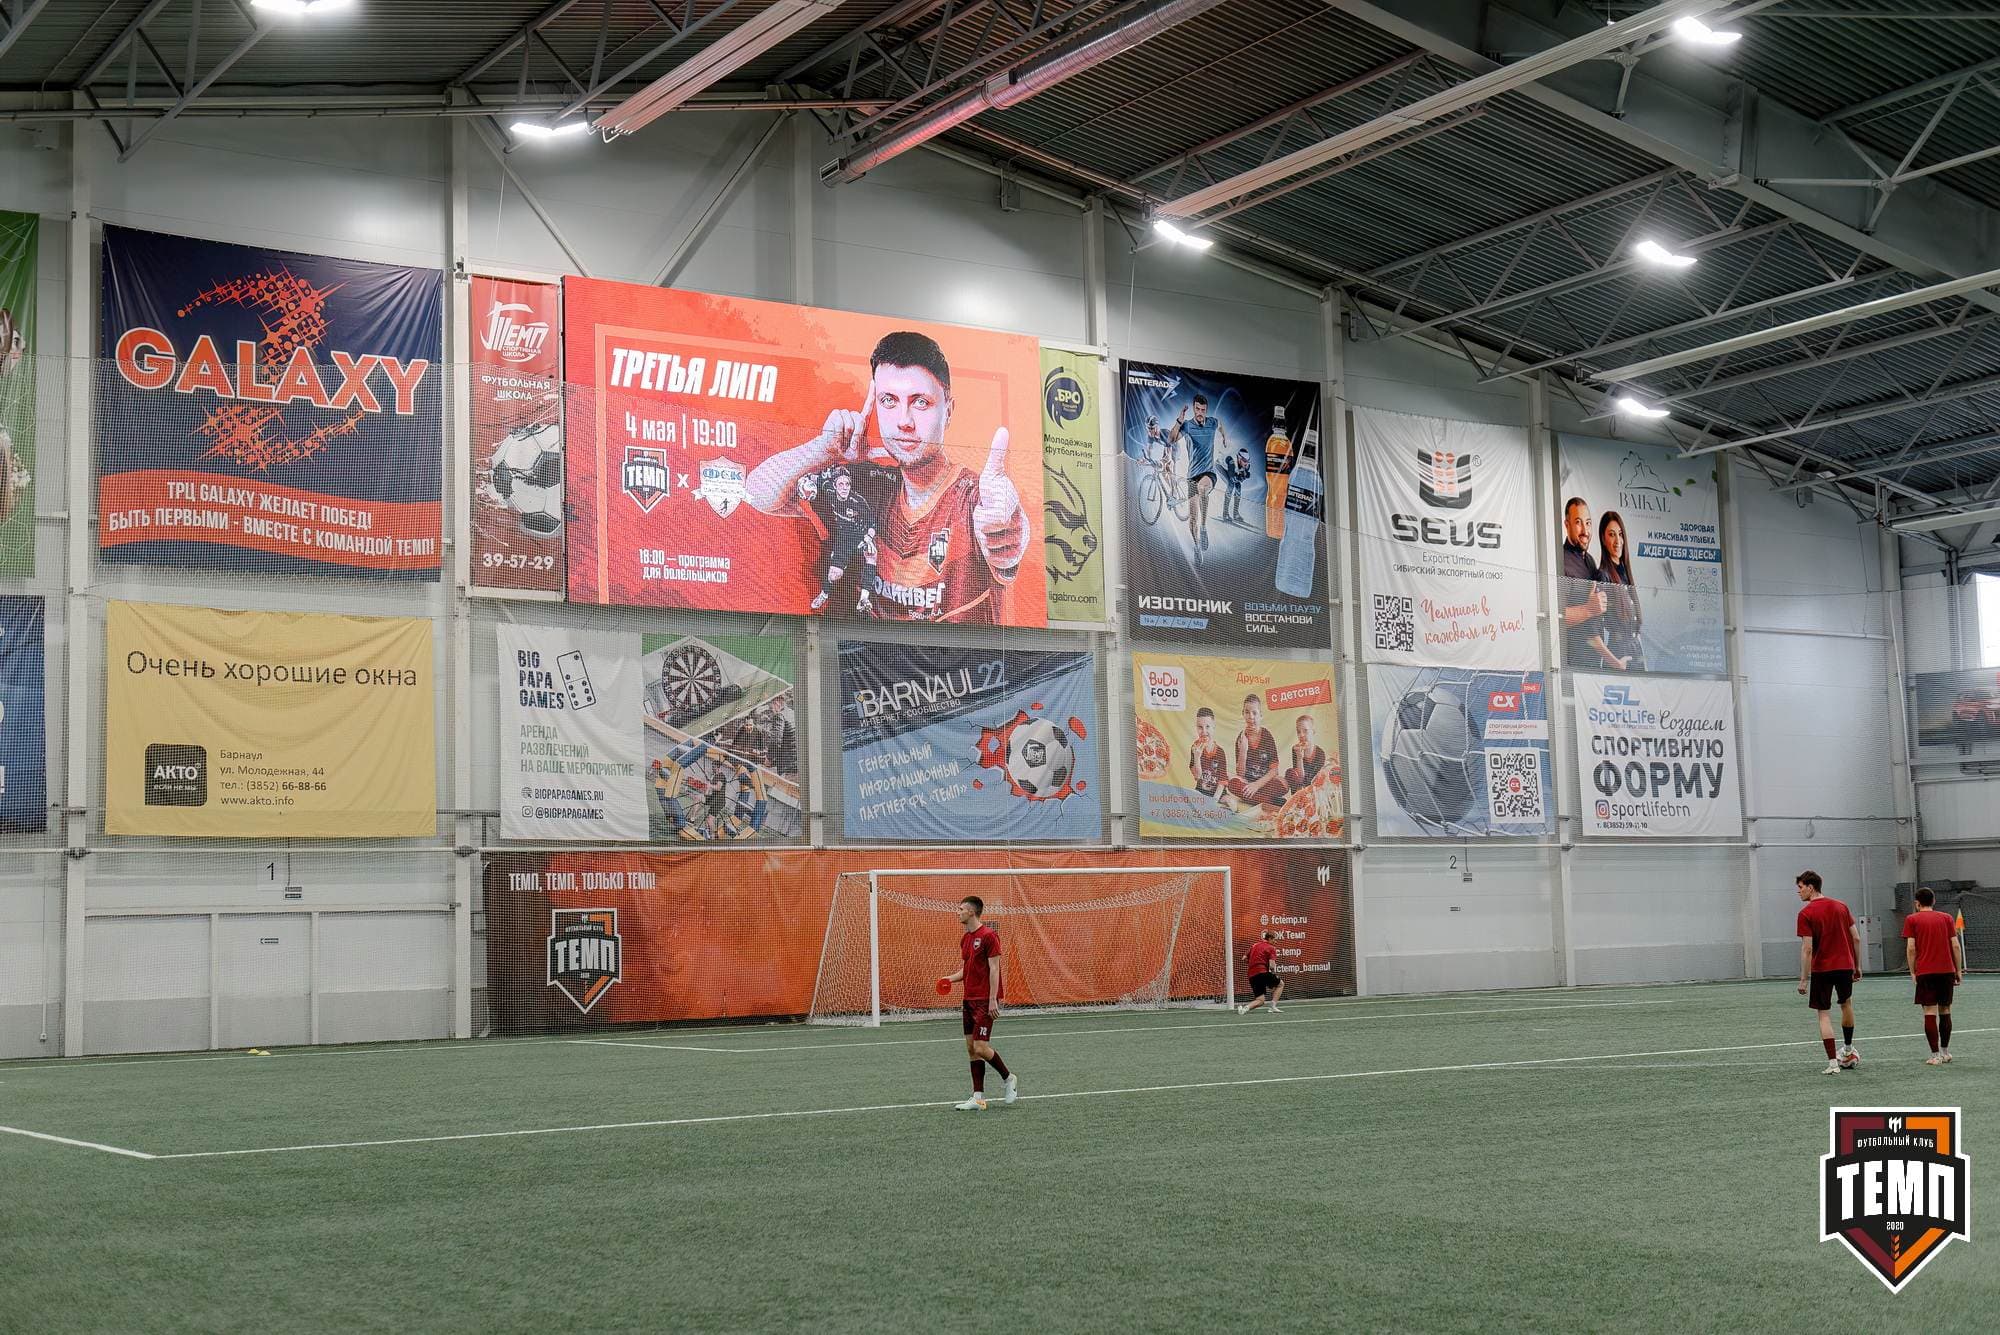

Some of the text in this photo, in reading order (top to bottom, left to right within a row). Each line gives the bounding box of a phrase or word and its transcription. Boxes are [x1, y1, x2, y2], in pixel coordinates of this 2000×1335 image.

[115, 326, 429, 415] GALAXY
[610, 347, 778, 403] ТРЕТЬЯ ЛИГА
[481, 375, 551, 389] ФУТБОЛЬНАЯ
[496, 391, 532, 400] ШКОЛА
[625, 411, 737, 448] 4 мая 19:00
[626, 465, 666, 490] ТЕМП
[167, 482, 372, 529] ТРЦ GALAXY ЖЕЛАЕТ ПОБЕД!
[109, 508, 151, 531] БЫТЬ
[154, 508, 229, 531] ПЕРВЫМИ
[243, 515, 299, 542] ВМЕСТЕ
[303, 528, 311, 545] С
[316, 529, 392, 556] КОМАНДОЙ
[396, 538, 434, 557] ТЕМП!
[1391, 513, 1502, 549] SEUS
[1680, 522, 1715, 533] ЗДОРОВАЯ
[1647, 530, 1715, 545] И КРАСИВАЯ УЛЫБКА
[483, 553, 553, 569] 39-57-29
[639, 548, 665, 565] 18:00
[678, 554, 730, 570] программа
[1422, 552, 1476, 566] Export Union
[1643, 544, 1716, 560] ЖДЕТ ТЕБЯ ЗДЕСЬ!
[643, 565, 728, 583] для болельщиков
[1392, 563, 1503, 580] СИБИРСКИЙ ЭКСПОРТНЫЙ СОЮЗ
[1138, 595, 1233, 614] ИЗОТОНИК
[1245, 602, 1287, 613] ВОЗЬМИ
[1421, 598, 1480, 622] Чемпион
[1245, 613, 1313, 625] ВОССТАНОВИ
[1425, 609, 1525, 645] каждом из нас!
[126, 650, 417, 686] Очень хорошие окна
[517, 650, 540, 668] BIG
[519, 670, 553, 690] PAPA
[1149, 671, 1178, 686] BuDu
[1235, 671, 1271, 686] Друзья
[519, 689, 565, 710] GAMES
[1151, 688, 1179, 698] FOOD
[1280, 685, 1322, 703] детства
[1602, 684, 1640, 706] SL
[1589, 707, 1656, 725] SportLife
[1660, 708, 1727, 737] Создаем
[520, 724, 558, 740] АРЕНДА
[220, 750, 263, 760] Барнаул
[520, 741, 589, 758] РАЗВЛЕЧЕНИЙ
[1591, 735, 1724, 758] СПОРТИВНУЮ
[858, 741, 933, 775] ГЕНЕРАЛЬНЫЙ
[220, 766, 324, 777] ул. Молодежная, 44
[520, 759, 635, 777] НА ВАШЕ МЕРОПРИЯТИЕ
[220, 780, 327, 792] тел.: (3852) 66-88-66
[859, 760, 961, 800] ИНФОРМАЦИОННЫЙ
[1593, 760, 1724, 799] ФОРМУ
[220, 795, 294, 806] www.akto.info
[534, 788, 604, 801] BIGPAPAGAMES.RU
[859, 782, 968, 823] ПАРТНЕР ФК «ТЕМП»
[535, 806, 604, 820] @BIGPAPAGAMES
[1611, 800, 1691, 820] sportlifebrn
[266, 862, 275, 881] 1
[1449, 855, 1457, 870] 2
[508, 871, 656, 893] ТЕМП, ТЕМП, ТОЛЬКО ТЕМП!
[1271, 915, 1308, 926] fctemp.ru
[1286, 930, 1306, 939] Темп
[555, 938, 615, 974] ТЕМП
[1275, 948, 1302, 957] c.temp
